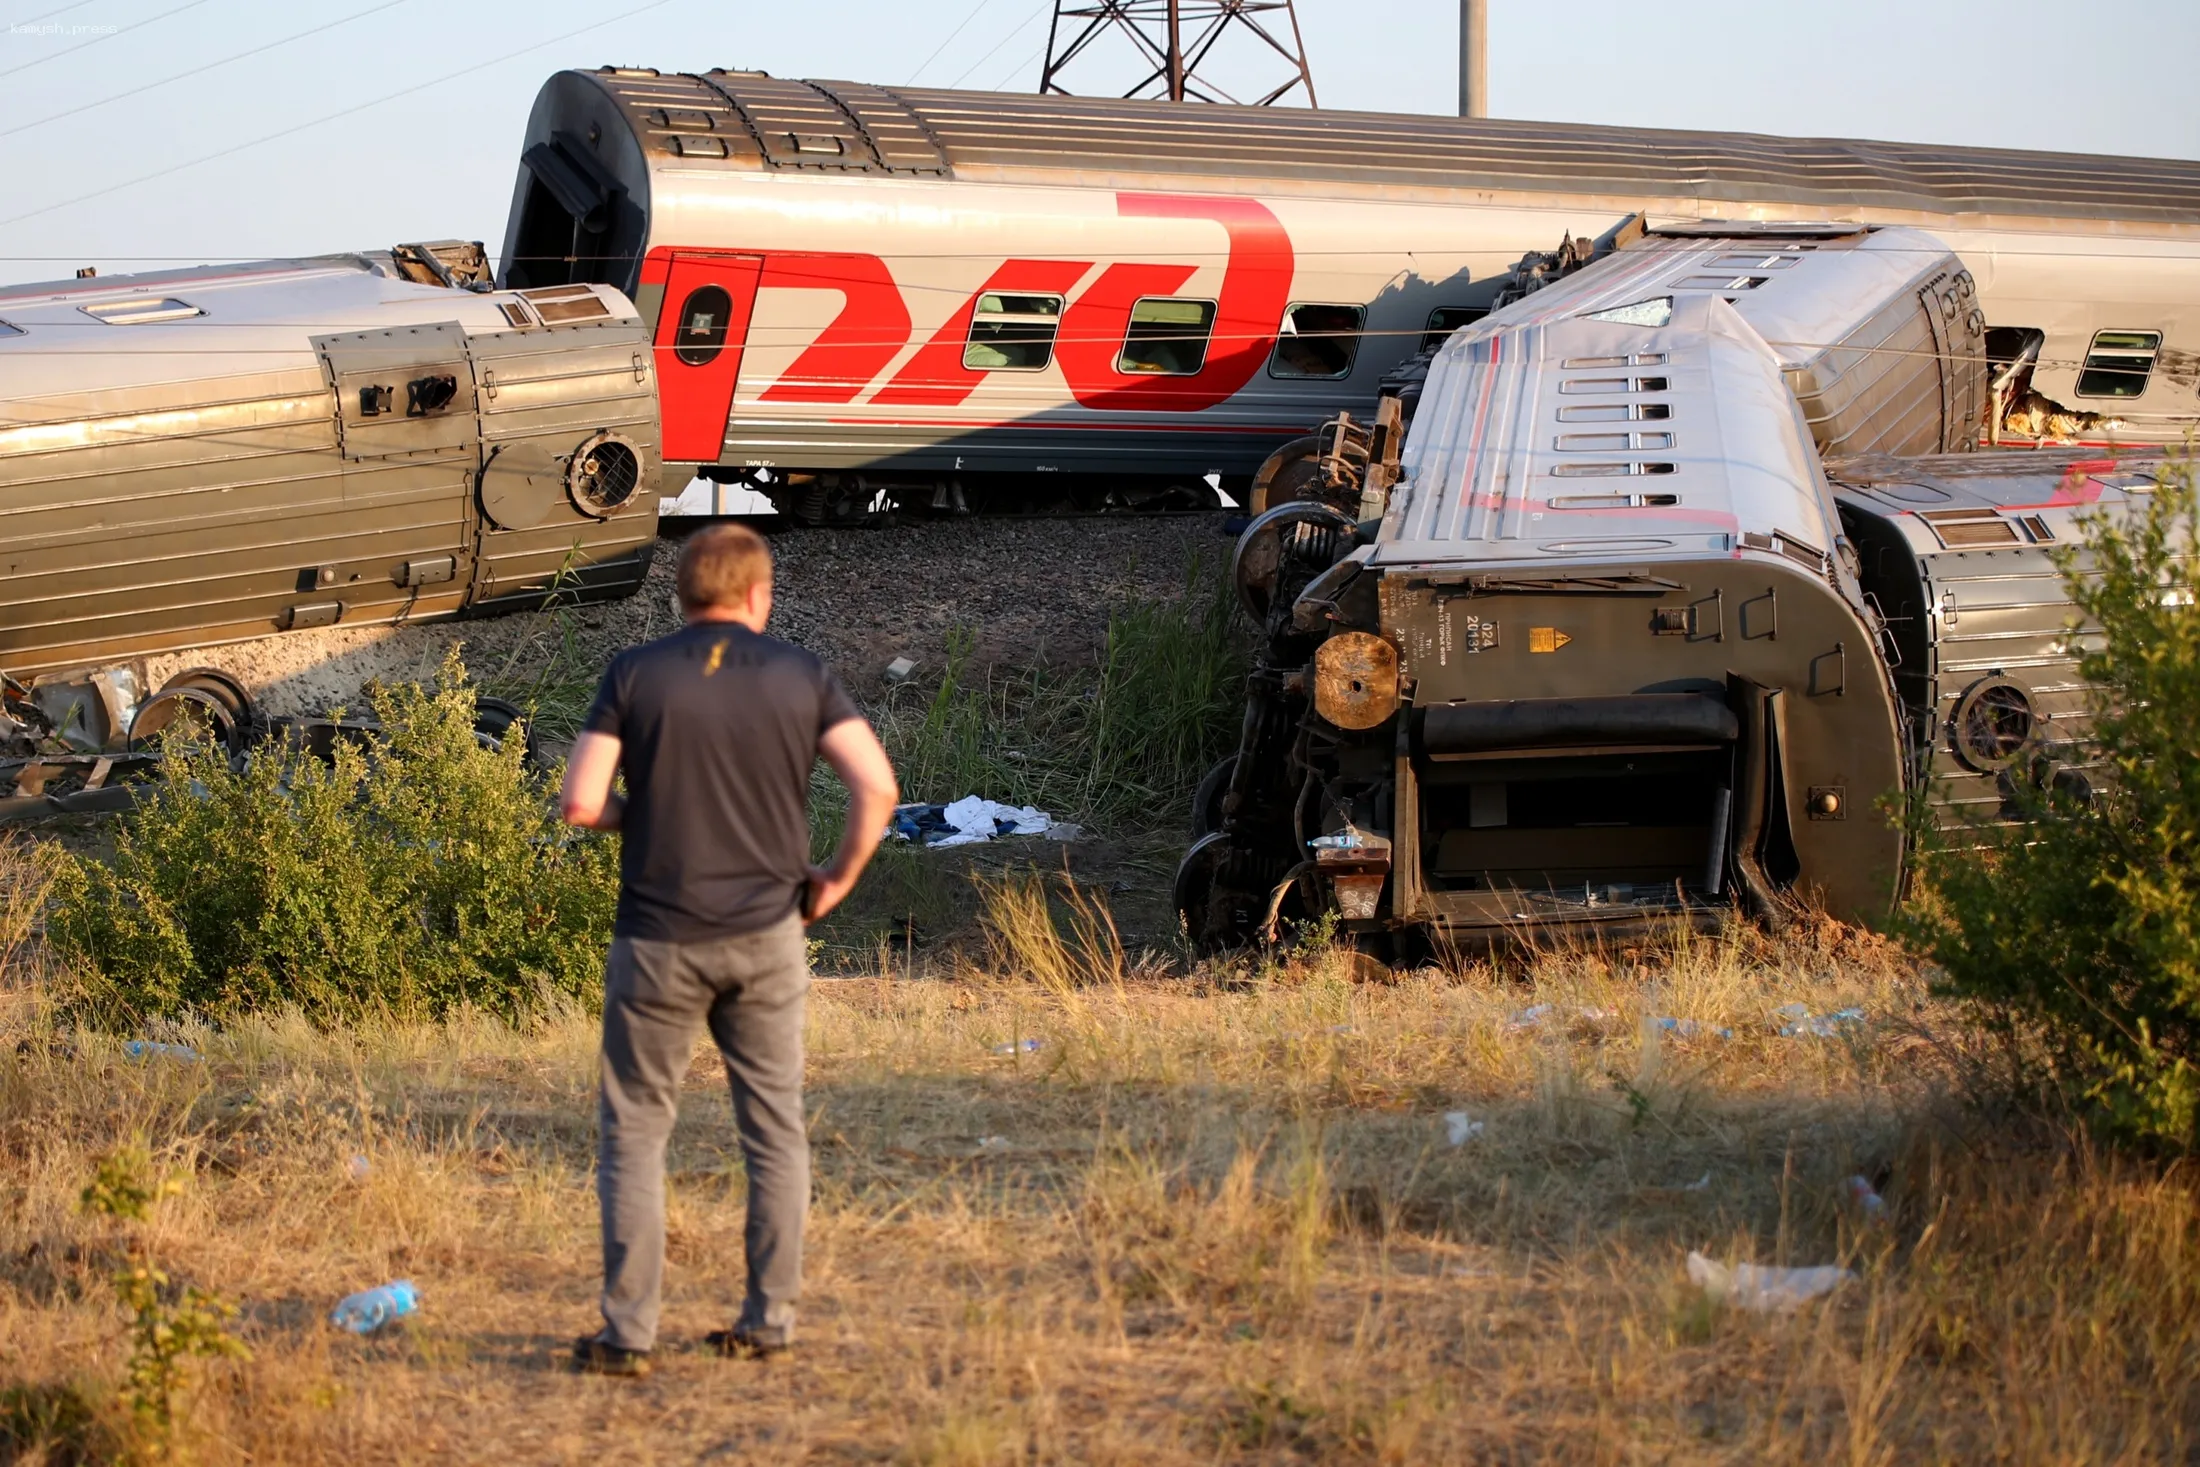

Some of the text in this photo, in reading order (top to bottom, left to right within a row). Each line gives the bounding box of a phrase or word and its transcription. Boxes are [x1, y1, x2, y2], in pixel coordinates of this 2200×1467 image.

[1445, 612, 1453, 652] ПРИПИСАН
[1467, 615, 1480, 654] 20131
[1481, 622, 1494, 647] 024
